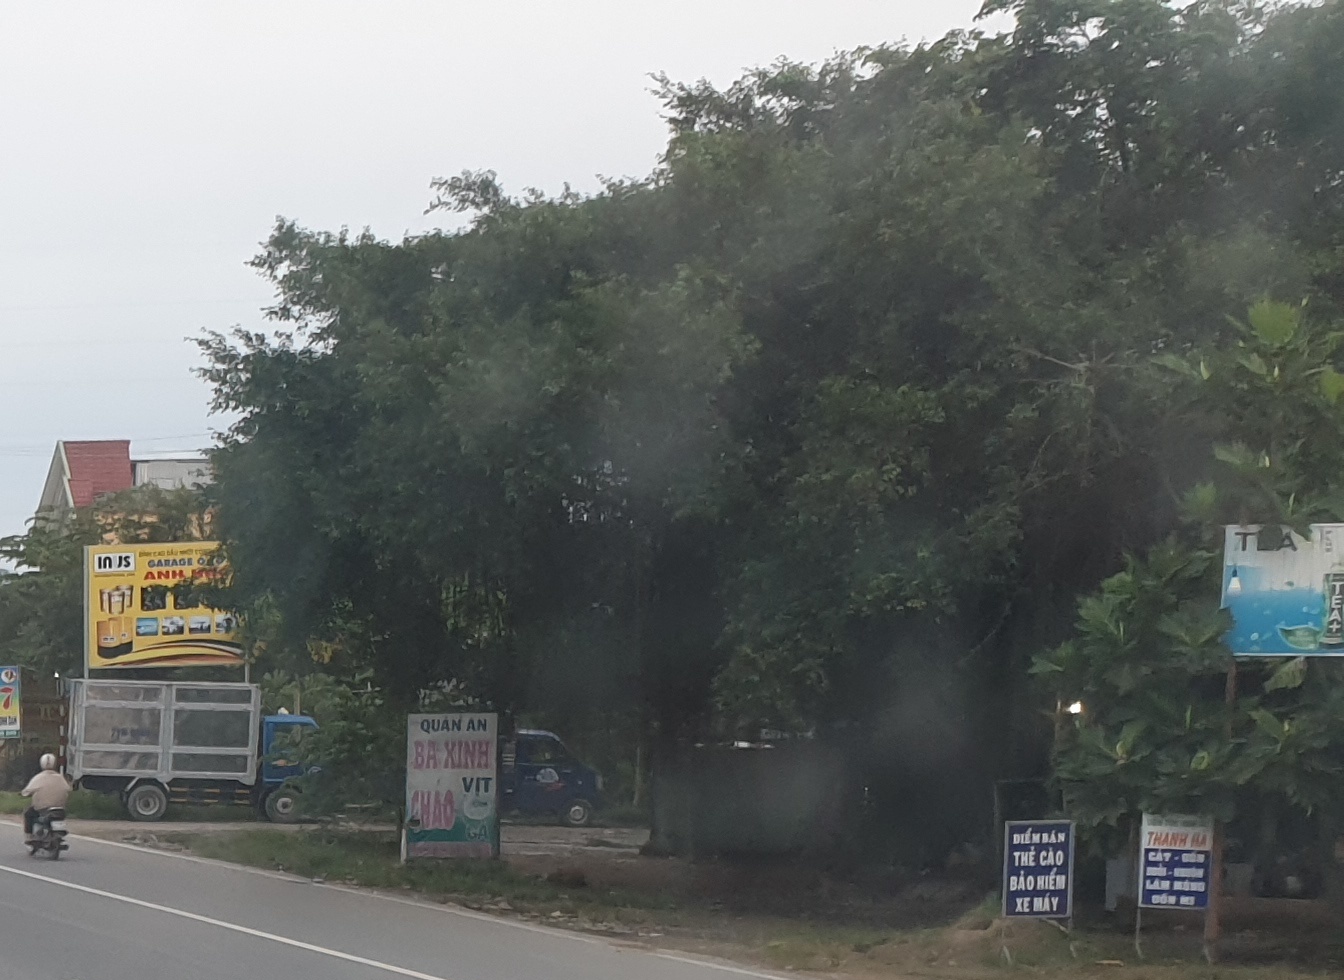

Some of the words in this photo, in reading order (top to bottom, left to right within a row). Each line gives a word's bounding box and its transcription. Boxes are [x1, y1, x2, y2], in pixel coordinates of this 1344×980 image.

[147, 557, 194, 569] GARAGE
[143, 569, 186, 581] ANH
[420, 717, 463, 733] QUÁN
[443, 739, 490, 769] XINH
[461, 776, 493, 797] VỊT
[1013, 846, 1036, 867] THẺ
[1039, 847, 1064, 867] CÀO
[1010, 870, 1034, 891] BẢO
[1036, 868, 1066, 891] HIỂM
[1015, 897, 1031, 913] XE
[1033, 893, 1059, 912] MÁY
